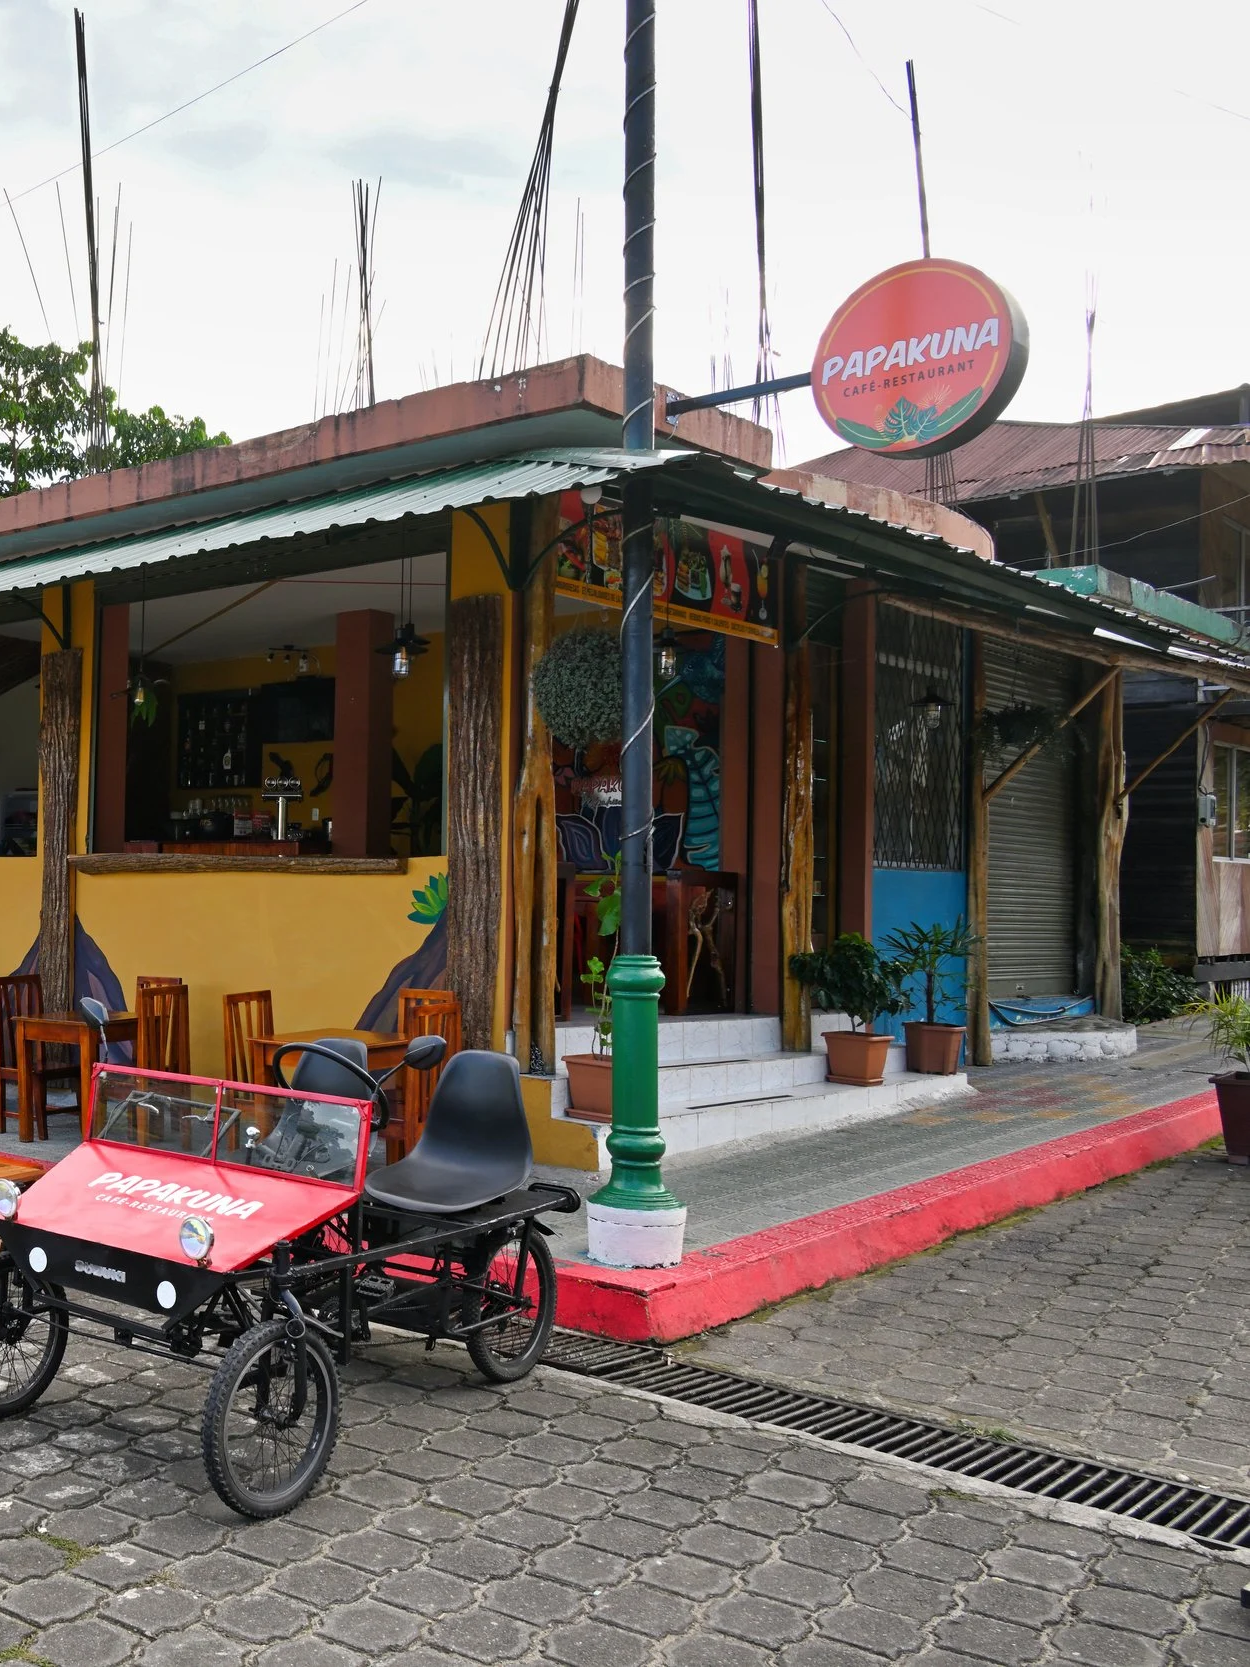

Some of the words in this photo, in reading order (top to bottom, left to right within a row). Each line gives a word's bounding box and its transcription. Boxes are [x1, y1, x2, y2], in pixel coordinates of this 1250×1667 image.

[821, 318, 999, 386] PAPAKUNA
[843, 359, 975, 398] CAFÉ-RESTAURANT
[88, 1172, 264, 1220] PAPAKUNA
